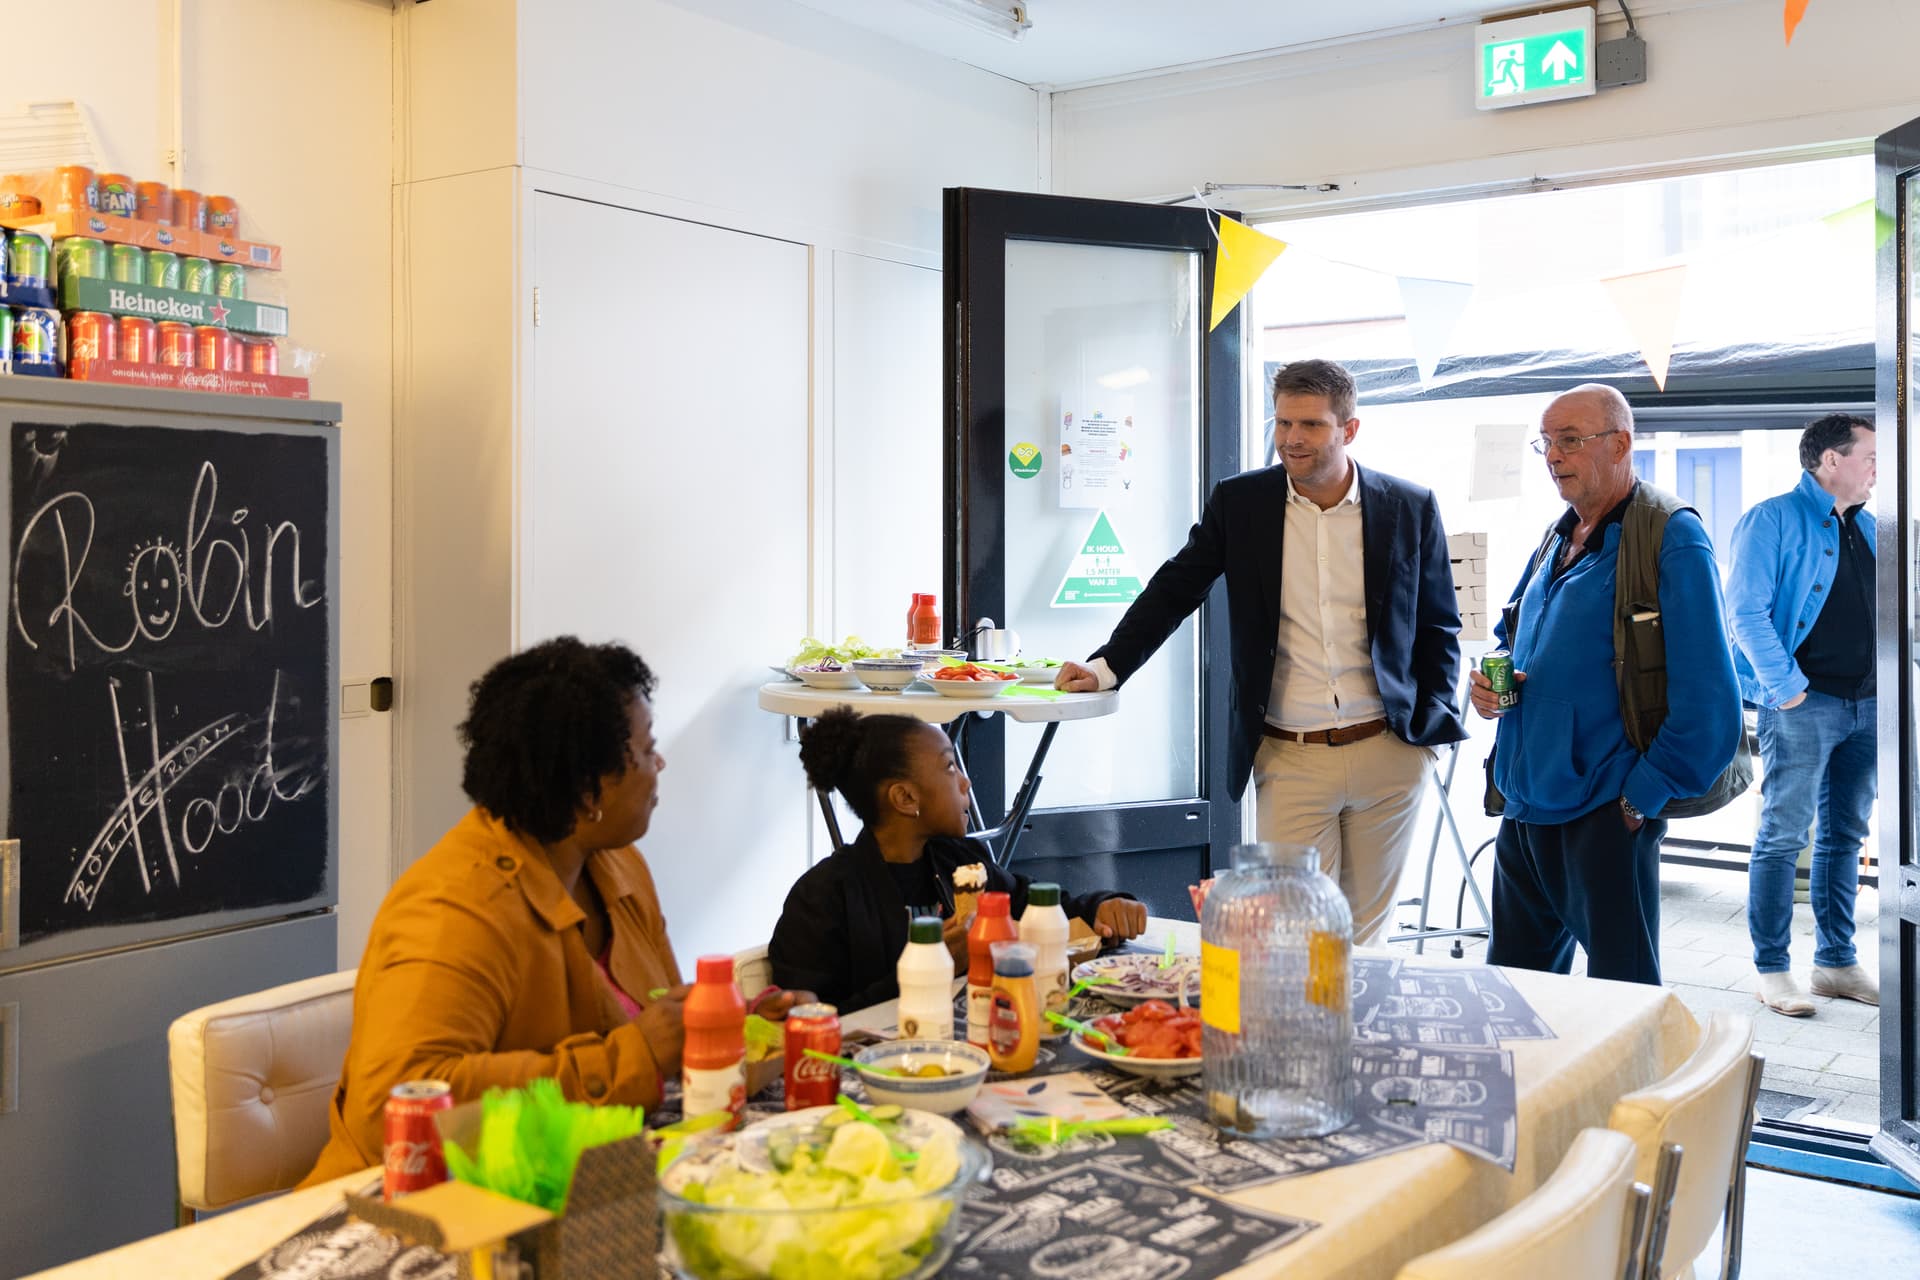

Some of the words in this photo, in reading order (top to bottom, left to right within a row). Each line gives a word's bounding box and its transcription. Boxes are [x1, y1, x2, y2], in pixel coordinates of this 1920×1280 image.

[110, 288, 203, 320] Heineken
[13, 460, 323, 673] Robin
[1097, 545, 1119, 553] HOUD
[73, 723, 230, 904] ROTTERDAM
[109, 668, 318, 894] Hood
